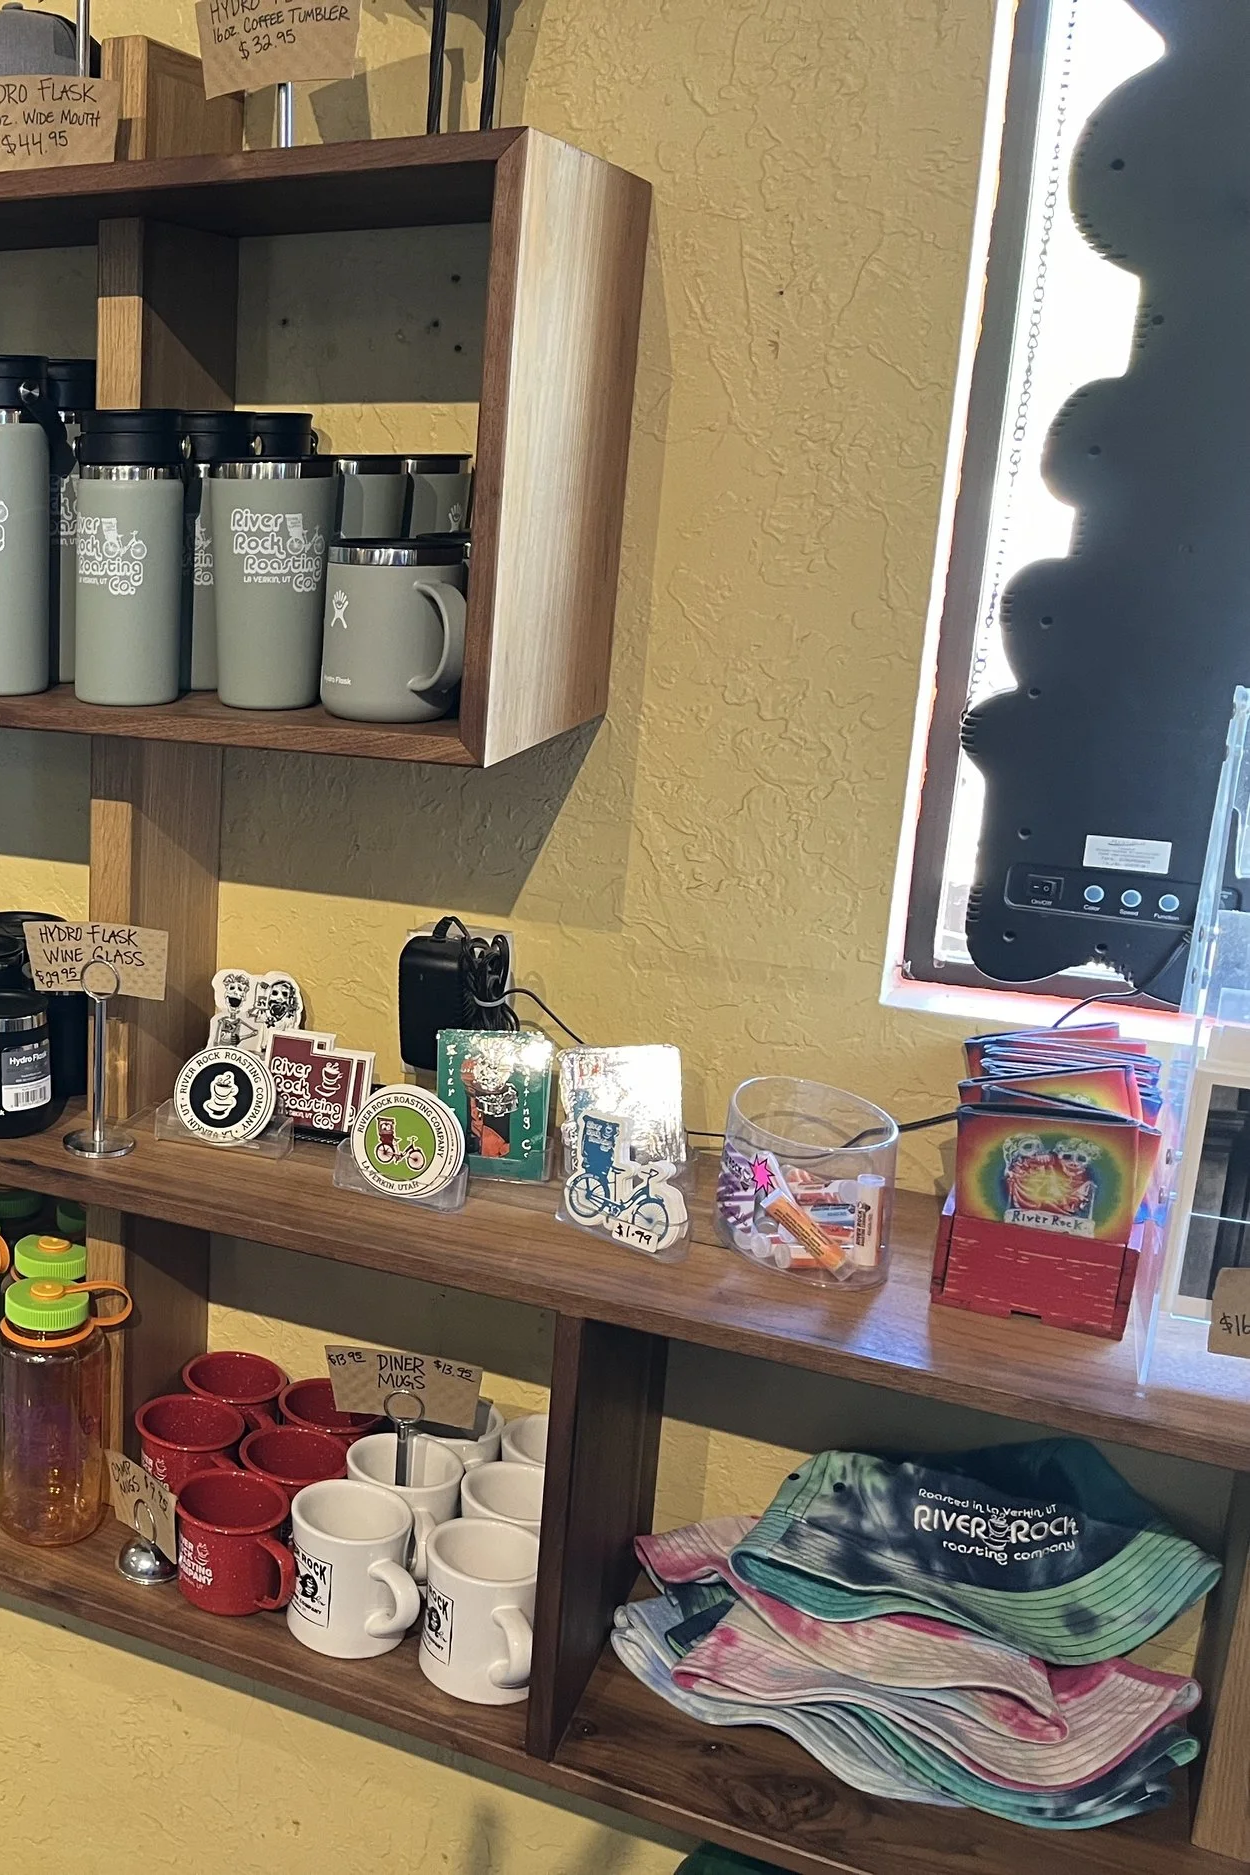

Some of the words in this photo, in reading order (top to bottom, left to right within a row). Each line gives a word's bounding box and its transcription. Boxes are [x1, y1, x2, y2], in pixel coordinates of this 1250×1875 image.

[244, 11, 284, 34] COFFEE
[288, 6, 350, 24] TUMBLER
[238, 29, 296, 60] $32.95
[38, 77, 97, 103] FLASK
[22, 109, 54, 126] WIDE
[60, 109, 101, 127] MOUTH
[1, 130, 69, 156] $44.95
[231, 508, 283, 531] River
[233, 532, 287, 559] Rock
[244, 554, 323, 583] Roasting
[282, 575, 292, 583] UT
[109, 575, 136, 595] Co.
[292, 573, 317, 592] Co.
[1031, 898, 1053, 907] On/Off
[1083, 904, 1101, 912] Color
[1119, 909, 1139, 917] Speed
[1153, 913, 1180, 921] Function
[39, 924, 82, 943] HYDRO
[87, 925, 139, 947] FLASK
[43, 946, 84, 965] WINE
[92, 945, 146, 967] GLASS
[35, 967, 77, 989] $29.95
[10, 1055, 33, 1067] Hydro
[196, 1051, 220, 1067] ROCK
[224, 1051, 262, 1084] ROASTING
[271, 1056, 312, 1078] River
[180, 1067, 197, 1094] RIVER
[273, 1075, 312, 1100] Rock
[180, 1103, 190, 1117] UT
[240, 1087, 264, 1131] COMPANY
[312, 1112, 335, 1131] Co.
[357, 1110, 374, 1134] RIVER
[371, 1097, 394, 1112] ROCK
[393, 1096, 434, 1118] ROASTING
[430, 1116, 445, 1159] COMPANY
[361, 1160, 371, 1171] LA
[368, 1170, 397, 1191] VERKIN,
[397, 1180, 420, 1191] UTAH
[1011, 1210, 1049, 1224] River
[614, 1224, 652, 1246] $1.99
[377, 1354, 426, 1376] DINER
[433, 1359, 475, 1382] $13.95
[378, 1373, 426, 1390] MUGS
[111, 1460, 131, 1482] CAMP
[119, 1475, 140, 1497] MUGS
[918, 1487, 970, 1508] Roasted
[972, 1500, 985, 1513] in
[1002, 1506, 1045, 1519] Verkin,
[1045, 1504, 1057, 1515] UT
[913, 1504, 989, 1540] RIVER
[1009, 1515, 1079, 1544] ROCK
[943, 1540, 1008, 1566] roasting
[1013, 1539, 1076, 1562] company
[301, 1552, 327, 1585] ROCK
